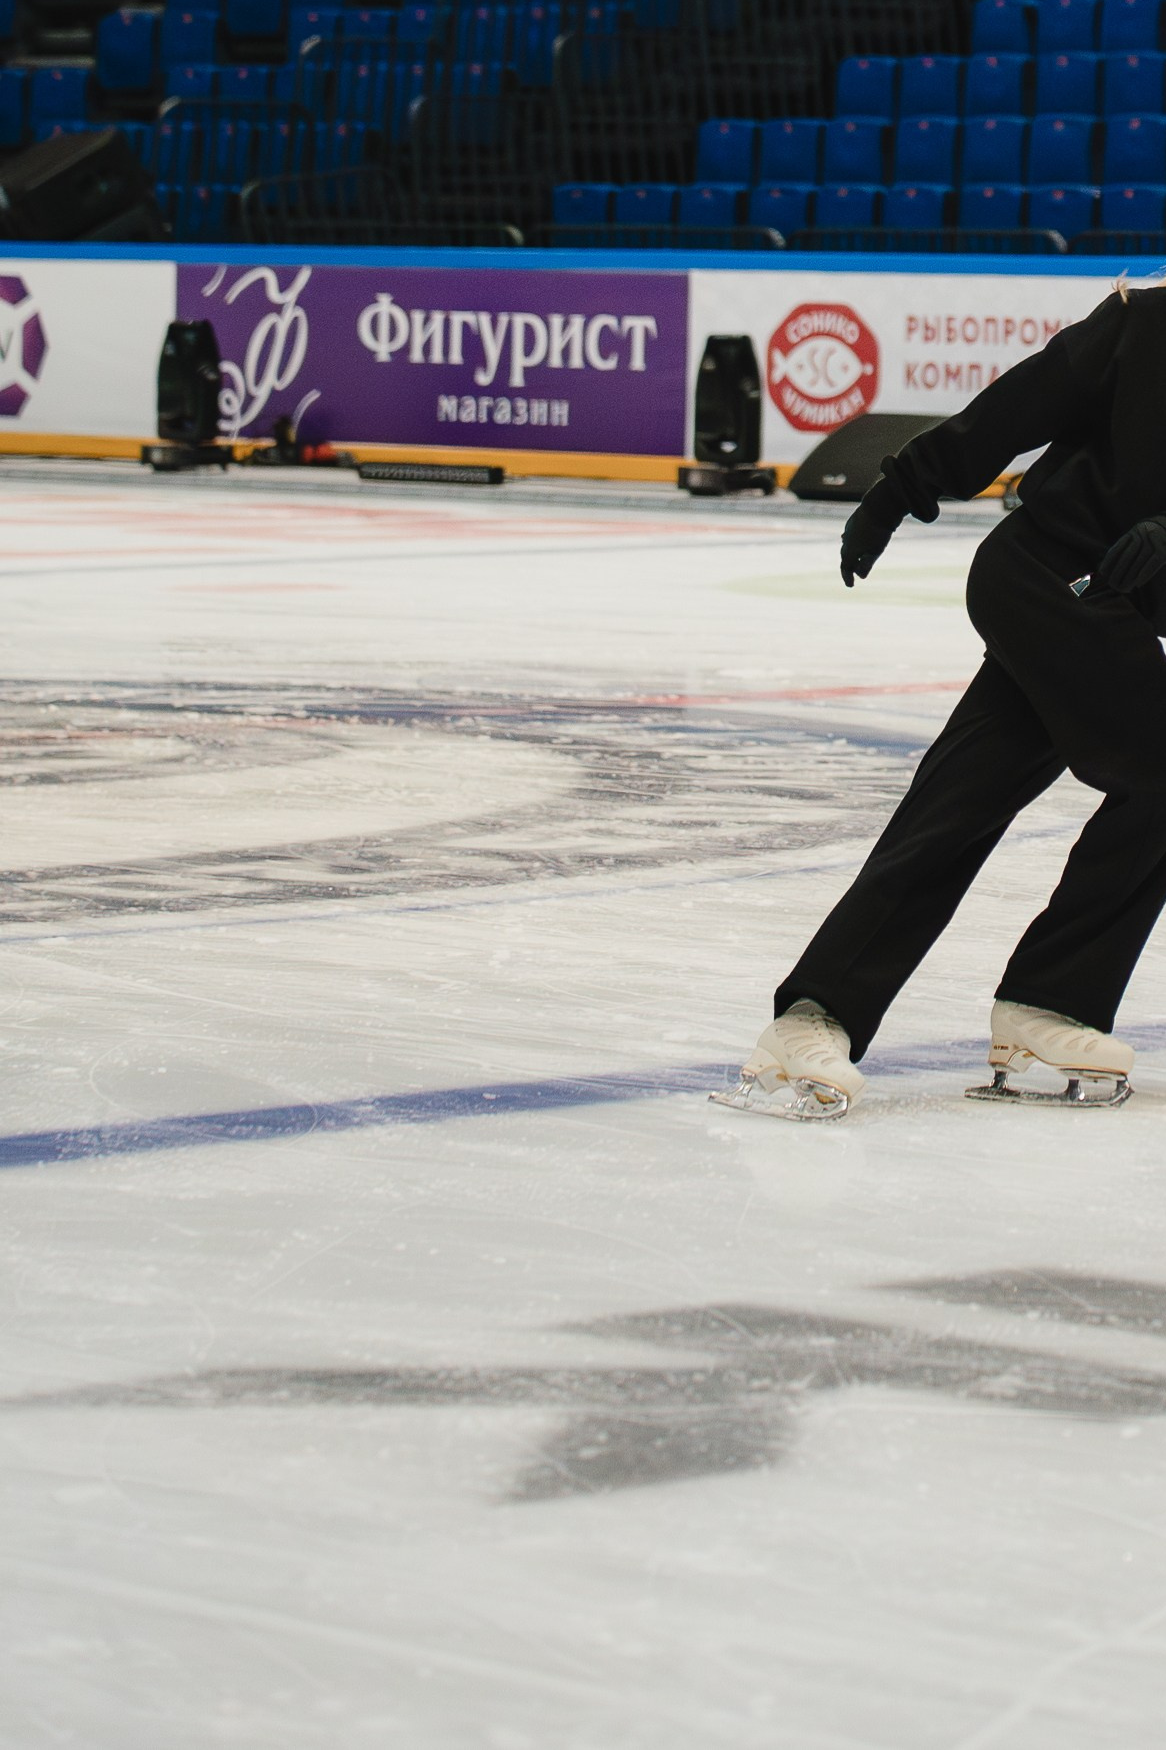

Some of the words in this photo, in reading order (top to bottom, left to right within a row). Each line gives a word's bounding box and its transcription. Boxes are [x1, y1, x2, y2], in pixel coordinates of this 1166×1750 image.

[357, 292, 657, 387] Фигурист
[904, 314, 1073, 346] РЫБОПРОМ
[904, 362, 1013, 392] КОМПА
[437, 395, 569, 426] магазин
